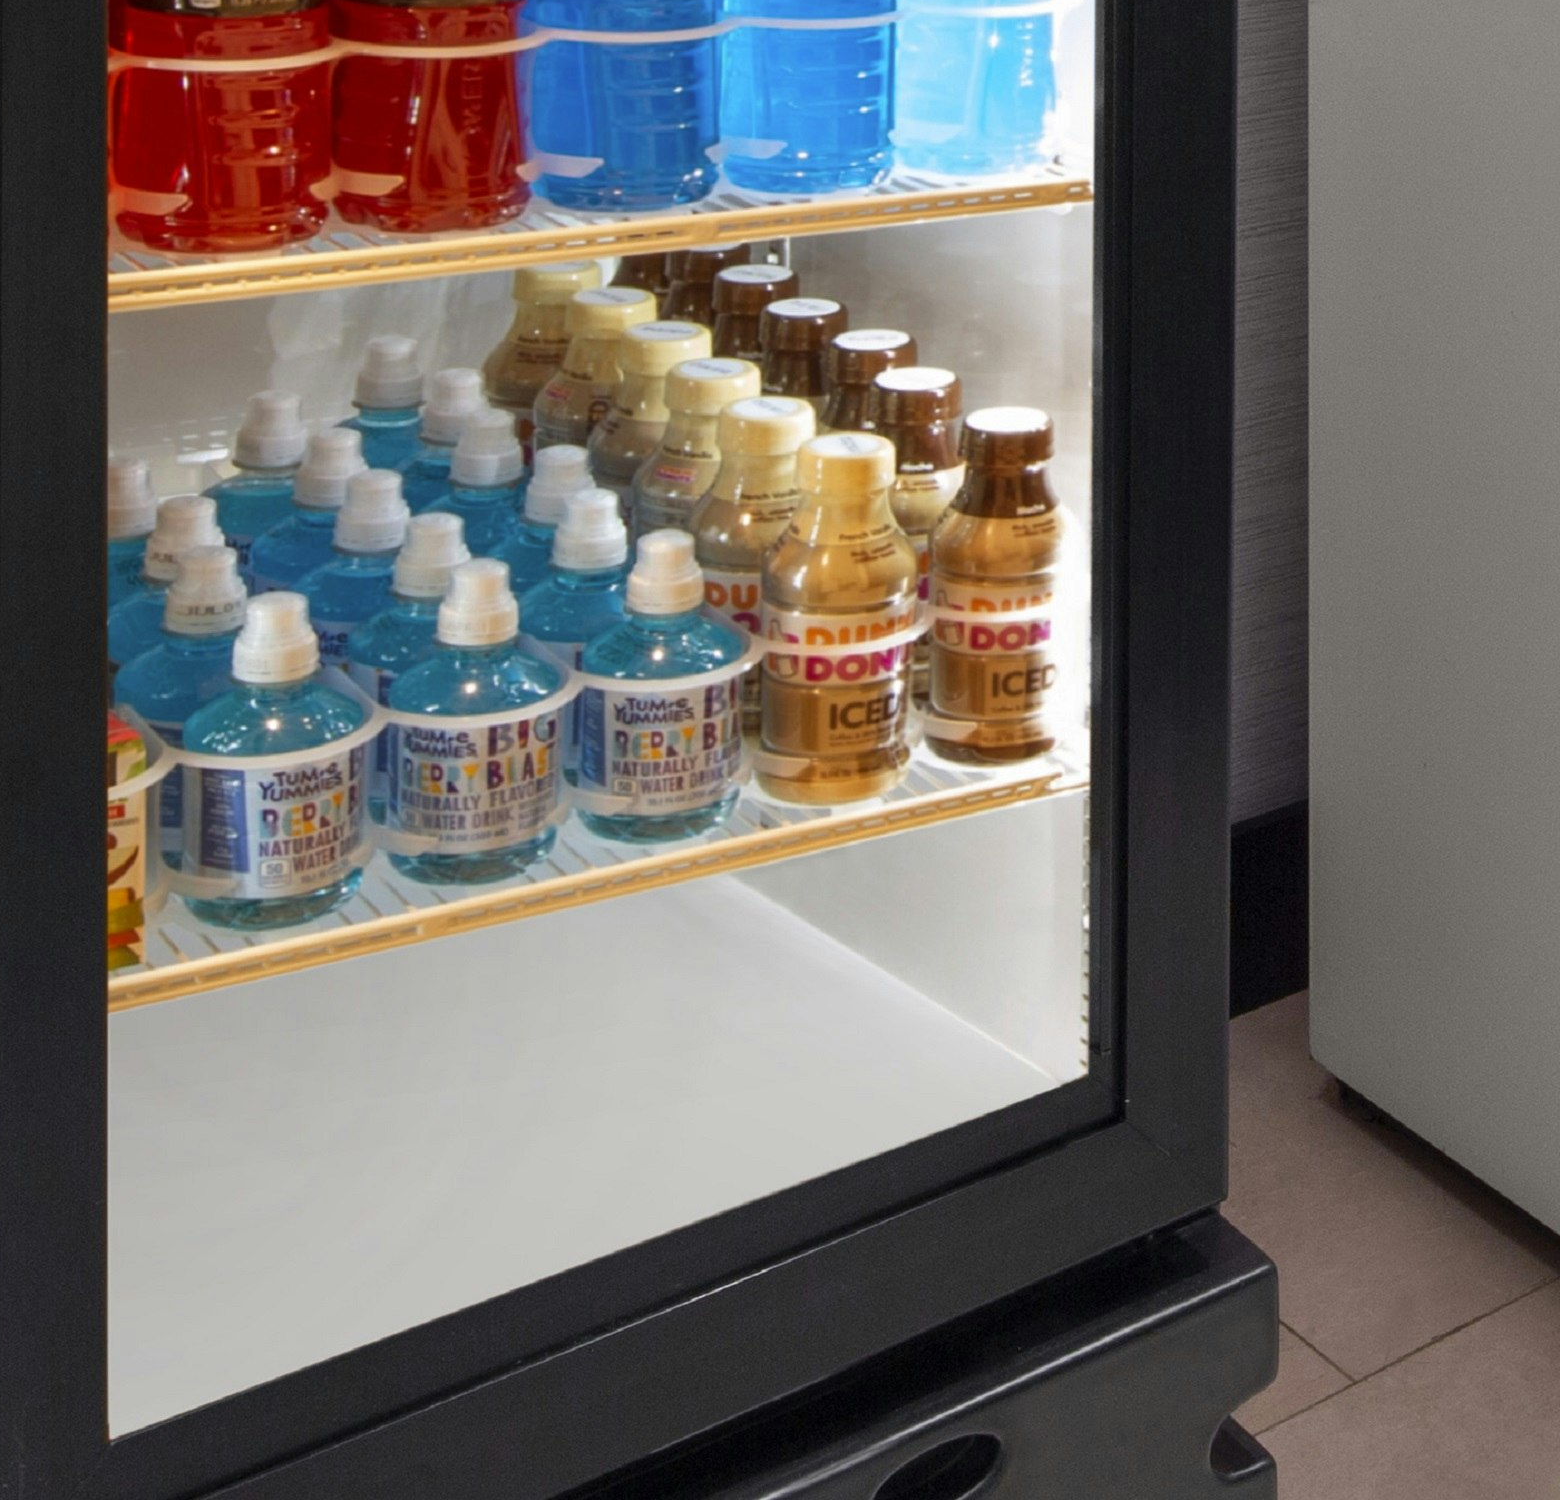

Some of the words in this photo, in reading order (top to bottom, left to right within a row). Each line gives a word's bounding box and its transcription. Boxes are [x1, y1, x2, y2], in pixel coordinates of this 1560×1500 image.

[991, 663, 1057, 699] ICED
[829, 693, 899, 730] ICED
[611, 758, 698, 781] NATURALLY
[258, 772, 344, 803] YUMMIES
[641, 774, 684, 795] WATER
[420, 810, 467, 831] WATER
[471, 806, 515, 828] DRINK
[293, 848, 336, 872] WATER
